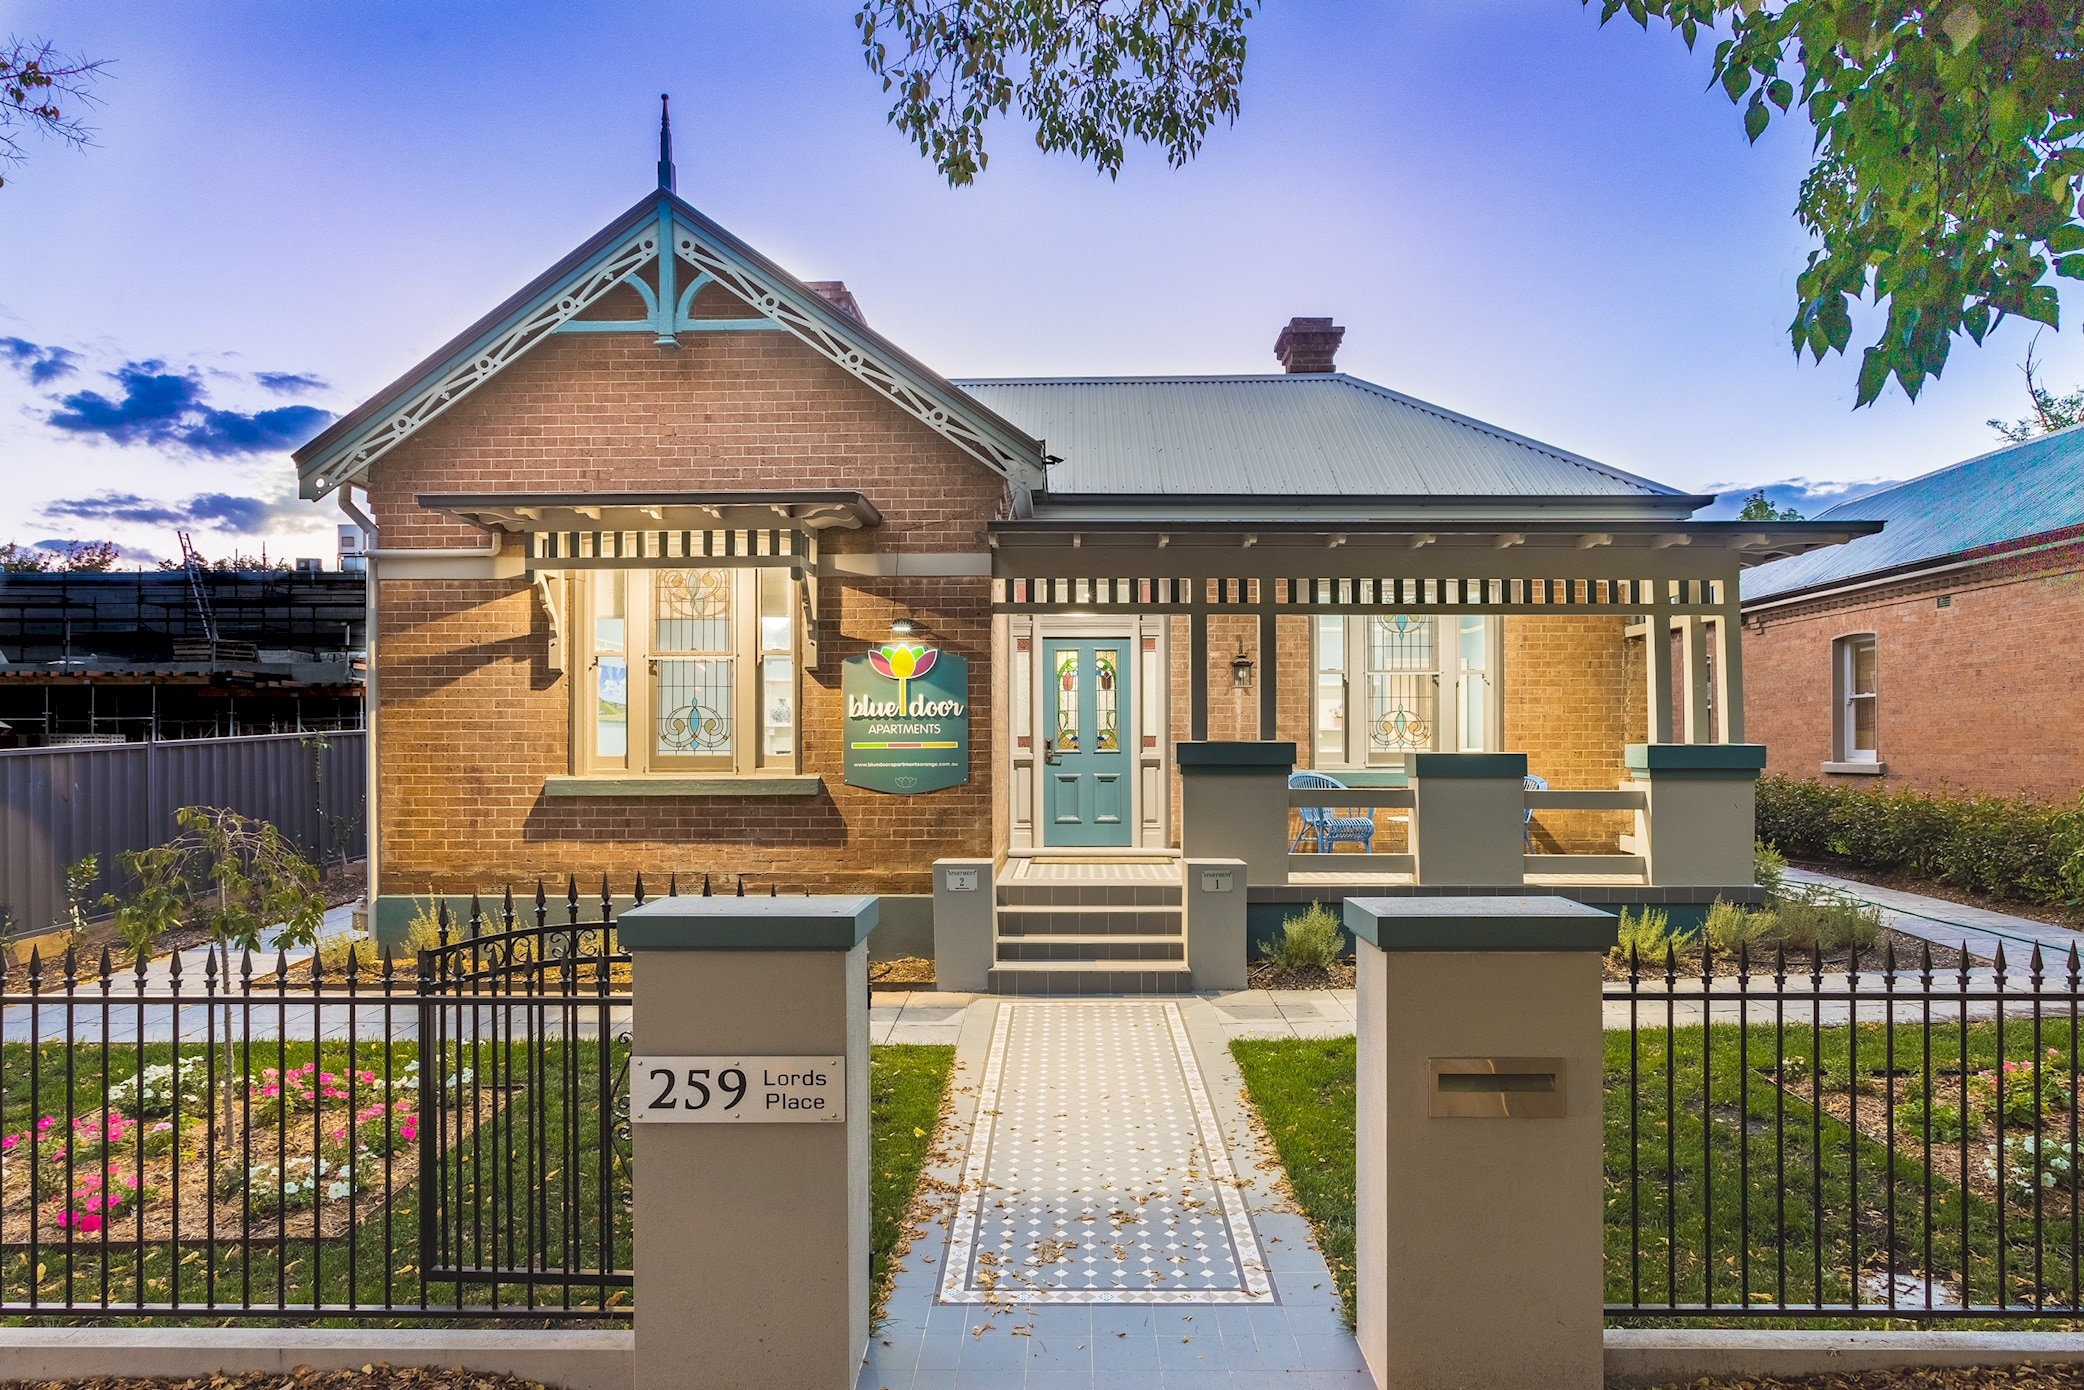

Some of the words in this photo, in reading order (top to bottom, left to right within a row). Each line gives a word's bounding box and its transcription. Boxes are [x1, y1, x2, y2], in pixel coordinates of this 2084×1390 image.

[848, 694, 901, 718] blue
[908, 694, 964, 718] door
[868, 723, 941, 735] APARTMENTS
[959, 877, 965, 887] 2
[1215, 879, 1220, 890] 1
[763, 1069, 827, 1086] Lords
[648, 1068, 747, 1111] 259
[765, 1093, 826, 1110] Place
